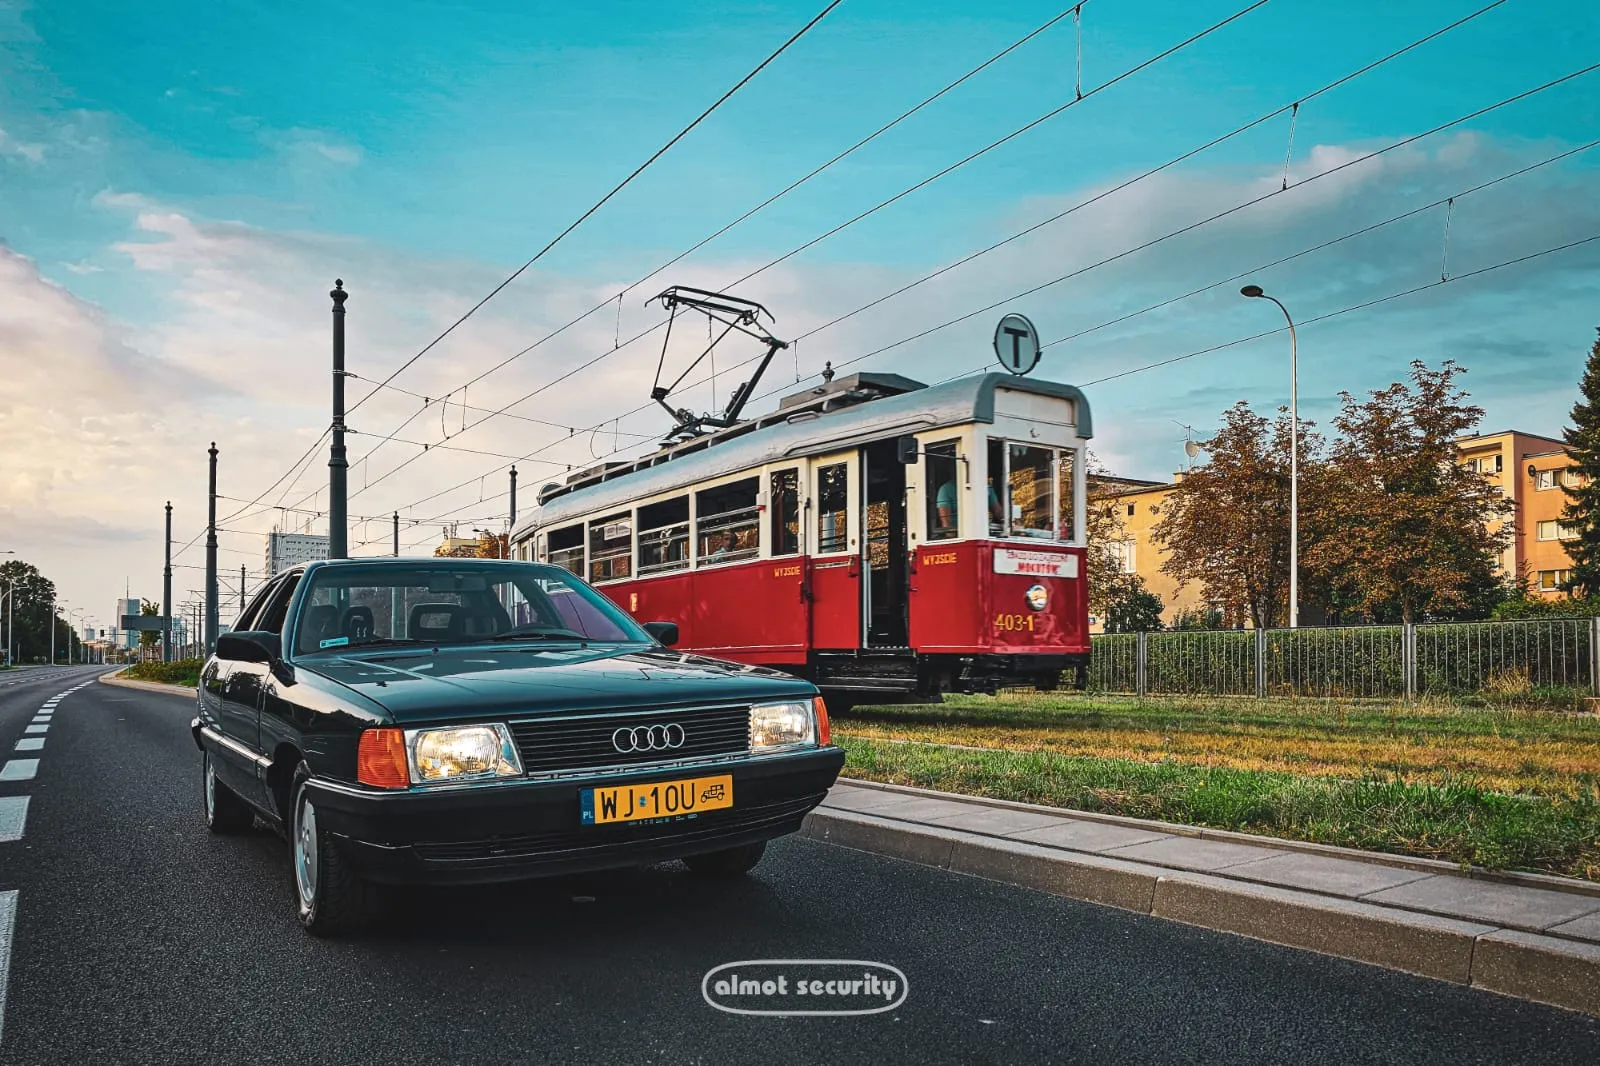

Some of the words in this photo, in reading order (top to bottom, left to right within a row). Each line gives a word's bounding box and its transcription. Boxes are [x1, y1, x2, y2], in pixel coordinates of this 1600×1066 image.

[1003, 326, 1028, 368] T
[994, 613, 1034, 632] 403-1
[601, 788, 634, 819] WJ
[650, 782, 695, 814] 10U
[582, 810, 594, 820] PL
